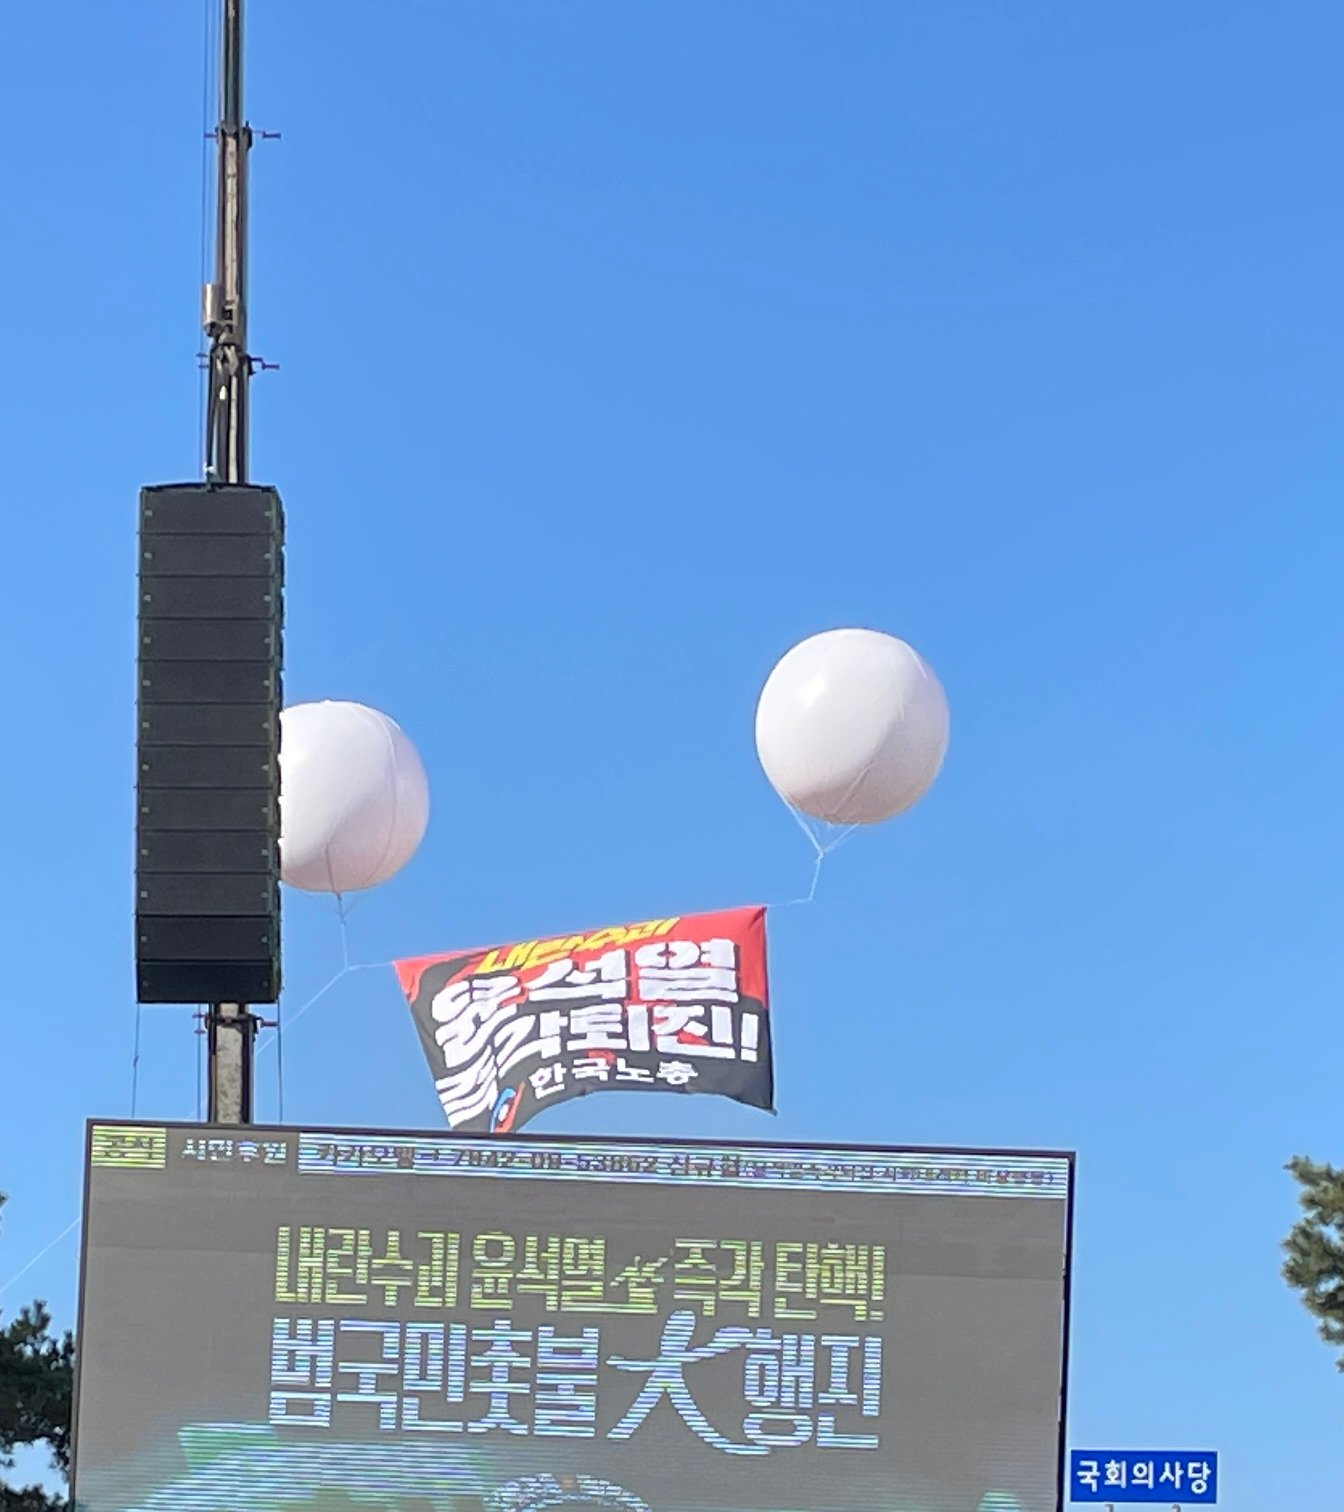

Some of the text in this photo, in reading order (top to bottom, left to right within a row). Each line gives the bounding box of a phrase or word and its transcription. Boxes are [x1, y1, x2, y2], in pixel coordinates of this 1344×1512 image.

[476, 917, 681, 975] 내란수괴
[431, 938, 739, 1068] 윤석열
[529, 1057, 698, 1099] 한국노총
[276, 1226, 886, 1321] 내란수괴 윤석열 즉각 탄핵!
[1077, 1459, 1211, 1494] 국회의사당
